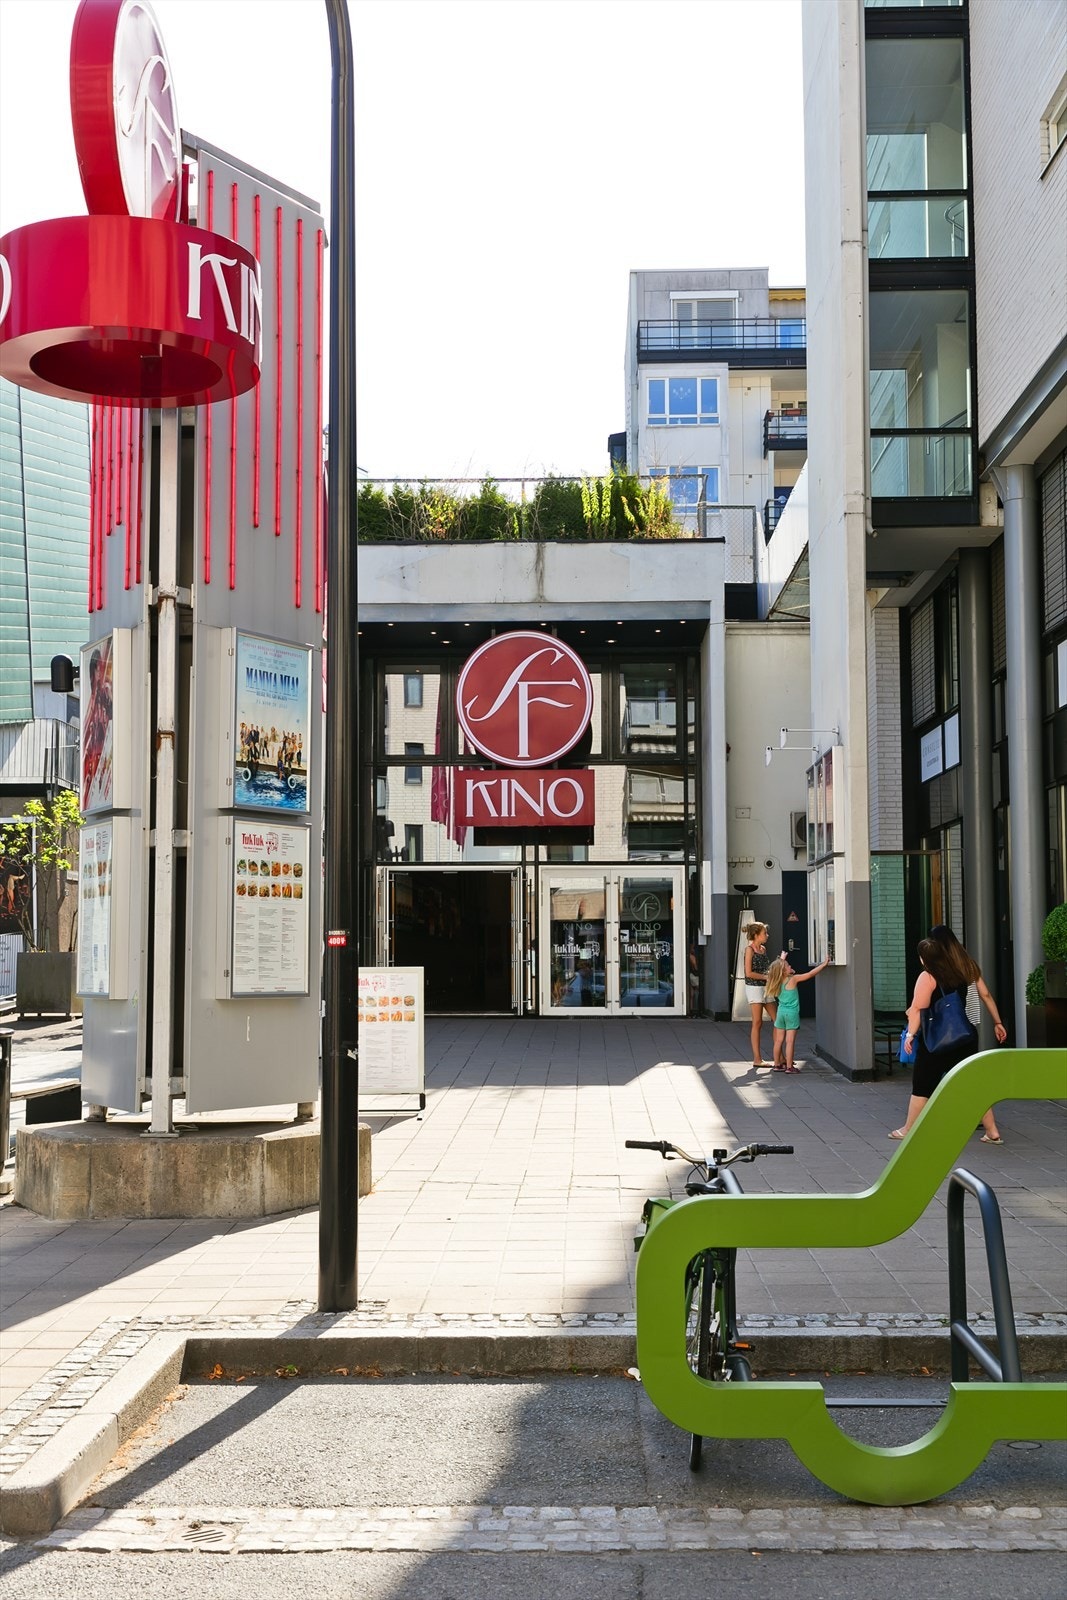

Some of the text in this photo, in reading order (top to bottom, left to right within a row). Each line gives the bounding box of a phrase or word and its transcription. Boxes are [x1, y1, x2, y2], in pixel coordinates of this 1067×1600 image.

[246, 667, 277, 691] MAMMA
[465, 777, 584, 818] KINO
[563, 922, 593, 931] KINO
[631, 922, 661, 931] KINO
